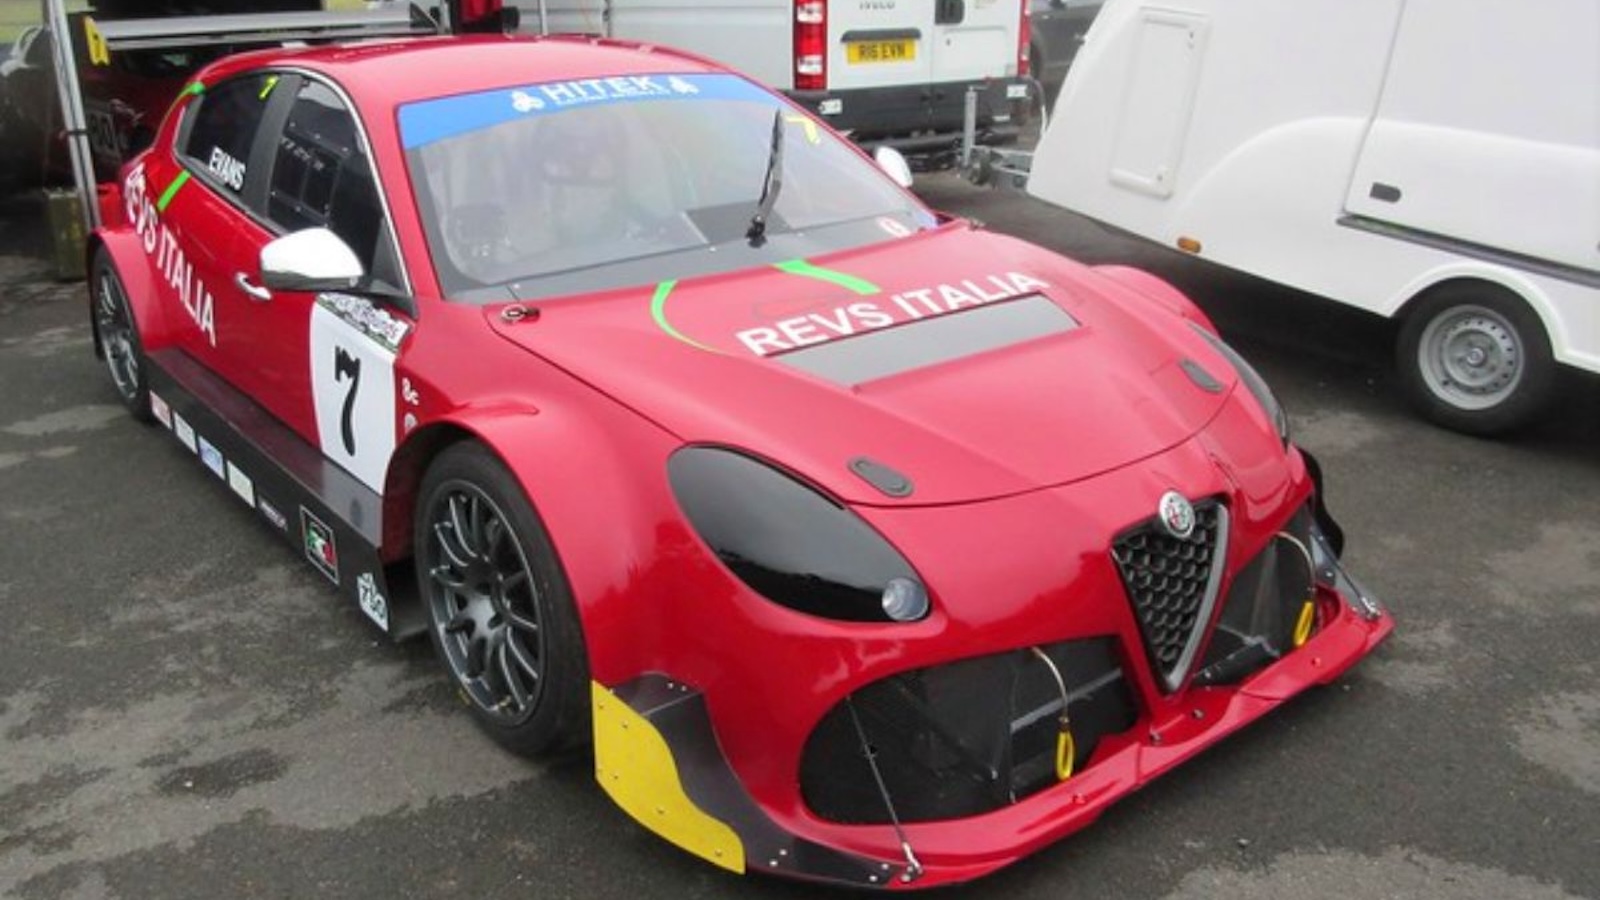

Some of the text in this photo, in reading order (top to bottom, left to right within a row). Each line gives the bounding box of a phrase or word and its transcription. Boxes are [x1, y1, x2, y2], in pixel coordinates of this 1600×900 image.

[540, 76, 664, 101] HITEK
[209, 146, 246, 190] EVANS
[124, 163, 158, 254] REVS
[157, 224, 216, 347] ITALIA
[735, 270, 1051, 357] REVS ITALIA
[334, 345, 361, 457] 7
